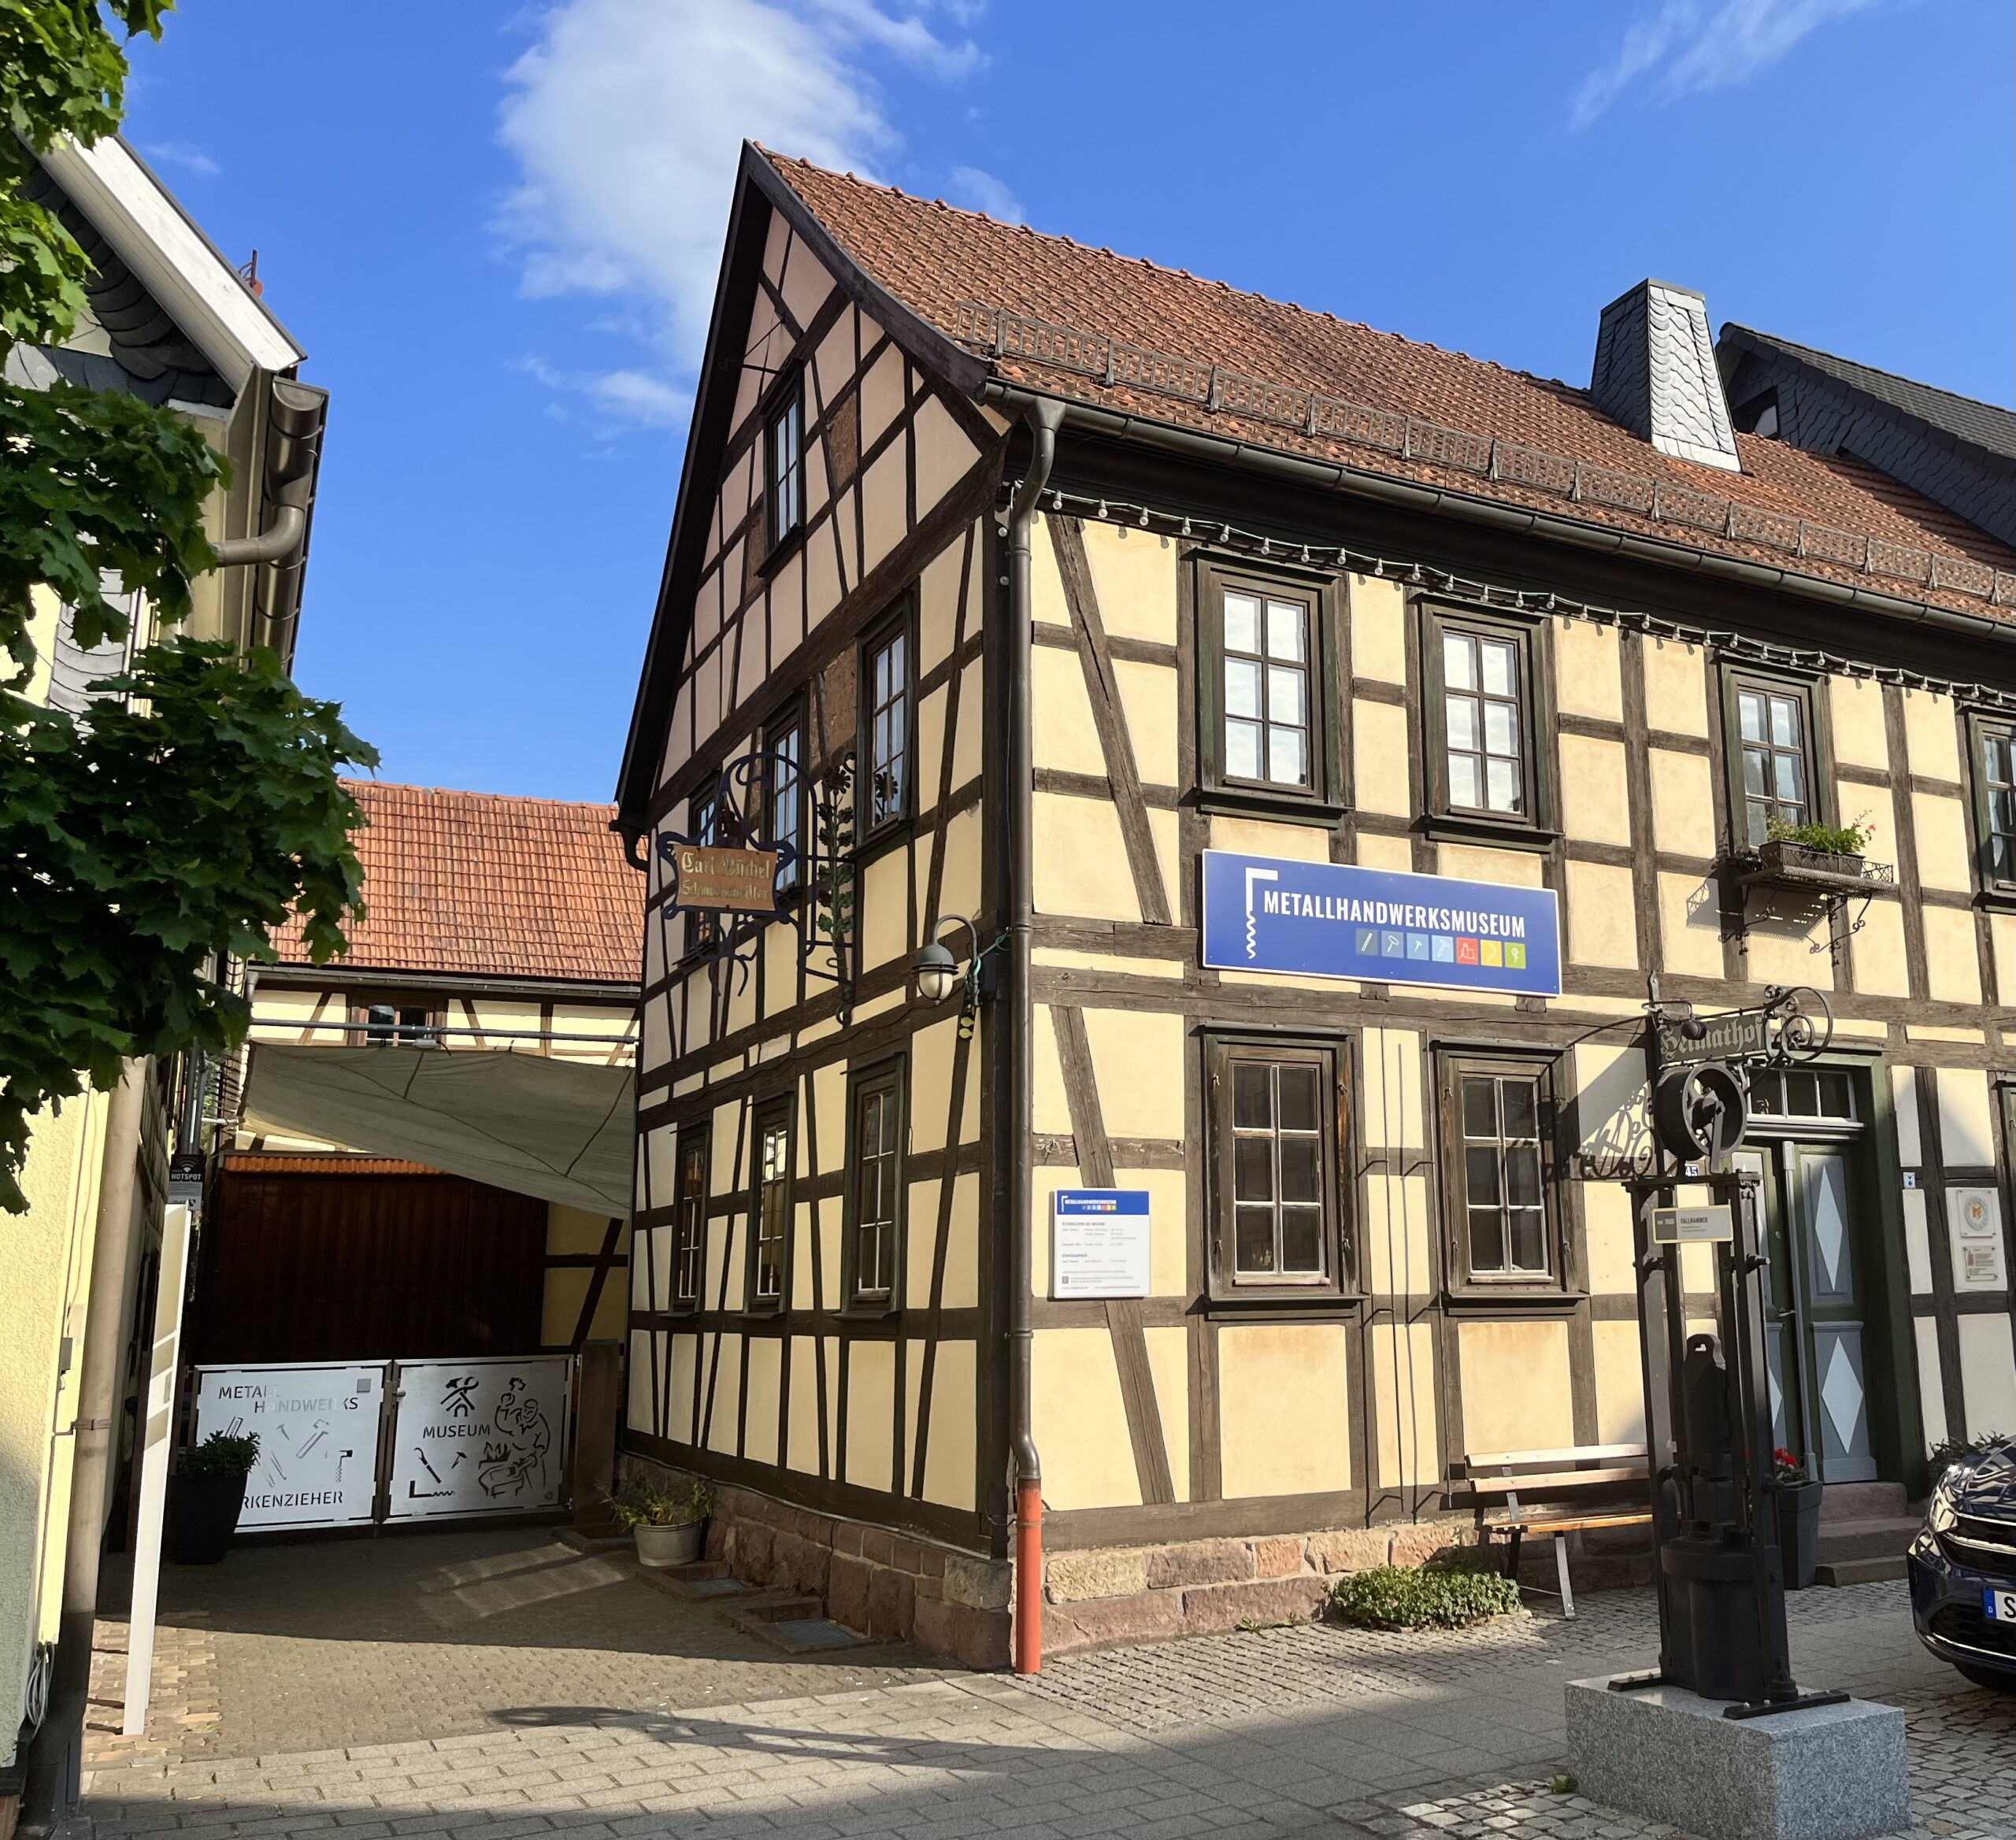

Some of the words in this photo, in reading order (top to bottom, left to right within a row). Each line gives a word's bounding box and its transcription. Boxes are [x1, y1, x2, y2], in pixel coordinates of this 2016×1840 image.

[1263, 889, 1525, 939] METALLHANDWERKSMUSEUM
[1685, 1166, 1698, 1176] 45
[423, 1424, 491, 1439] MUSEUM
[243, 1490, 343, 1509] RKENZIEHER
